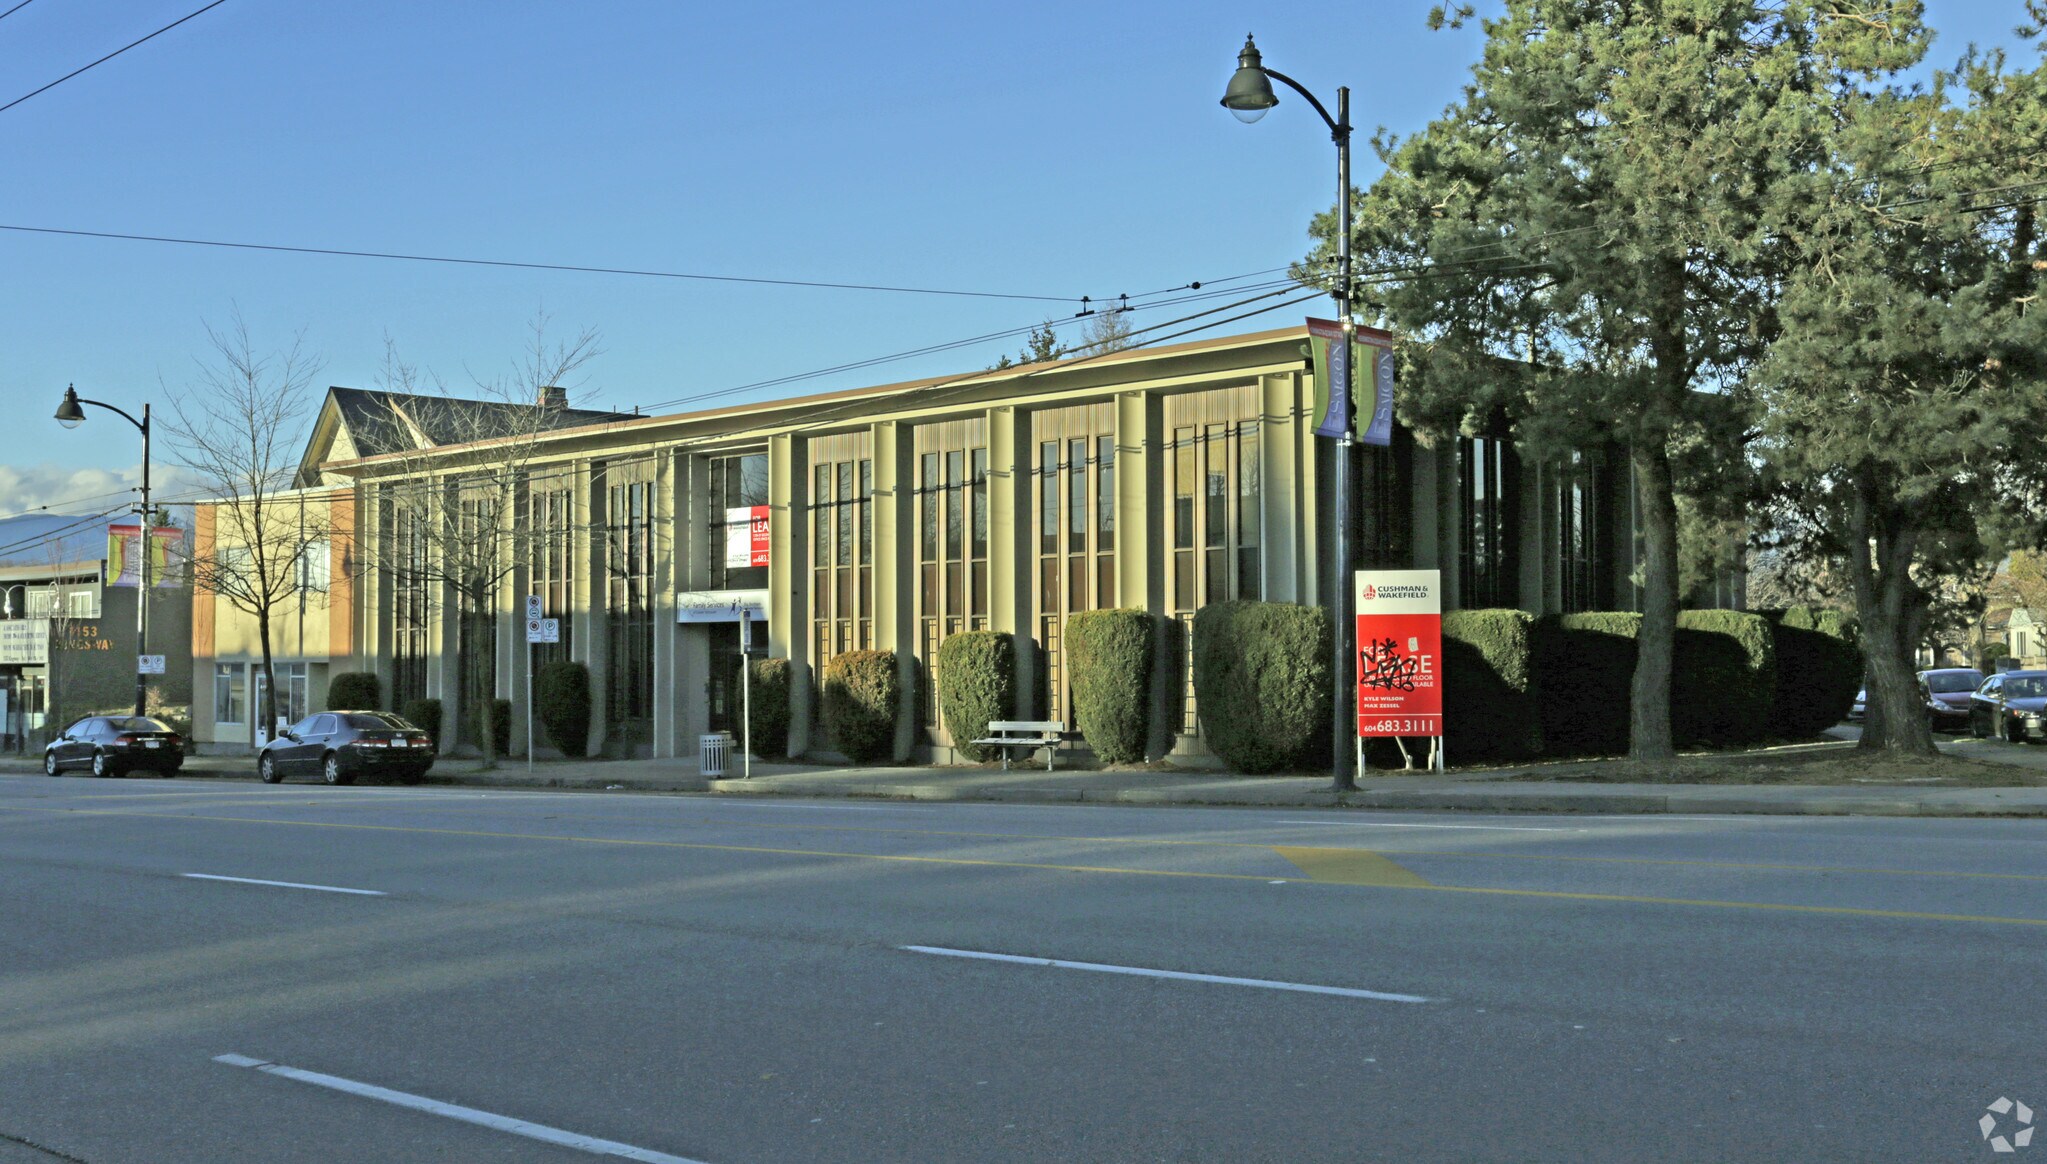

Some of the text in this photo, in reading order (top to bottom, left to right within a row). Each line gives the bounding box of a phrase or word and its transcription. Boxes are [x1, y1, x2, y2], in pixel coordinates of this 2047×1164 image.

[1330, 344, 1344, 414] SAIGON
[1377, 352, 1391, 422] SAIGON
[1363, 646, 1384, 655] FOR
[1364, 654, 1432, 674] LEASE
